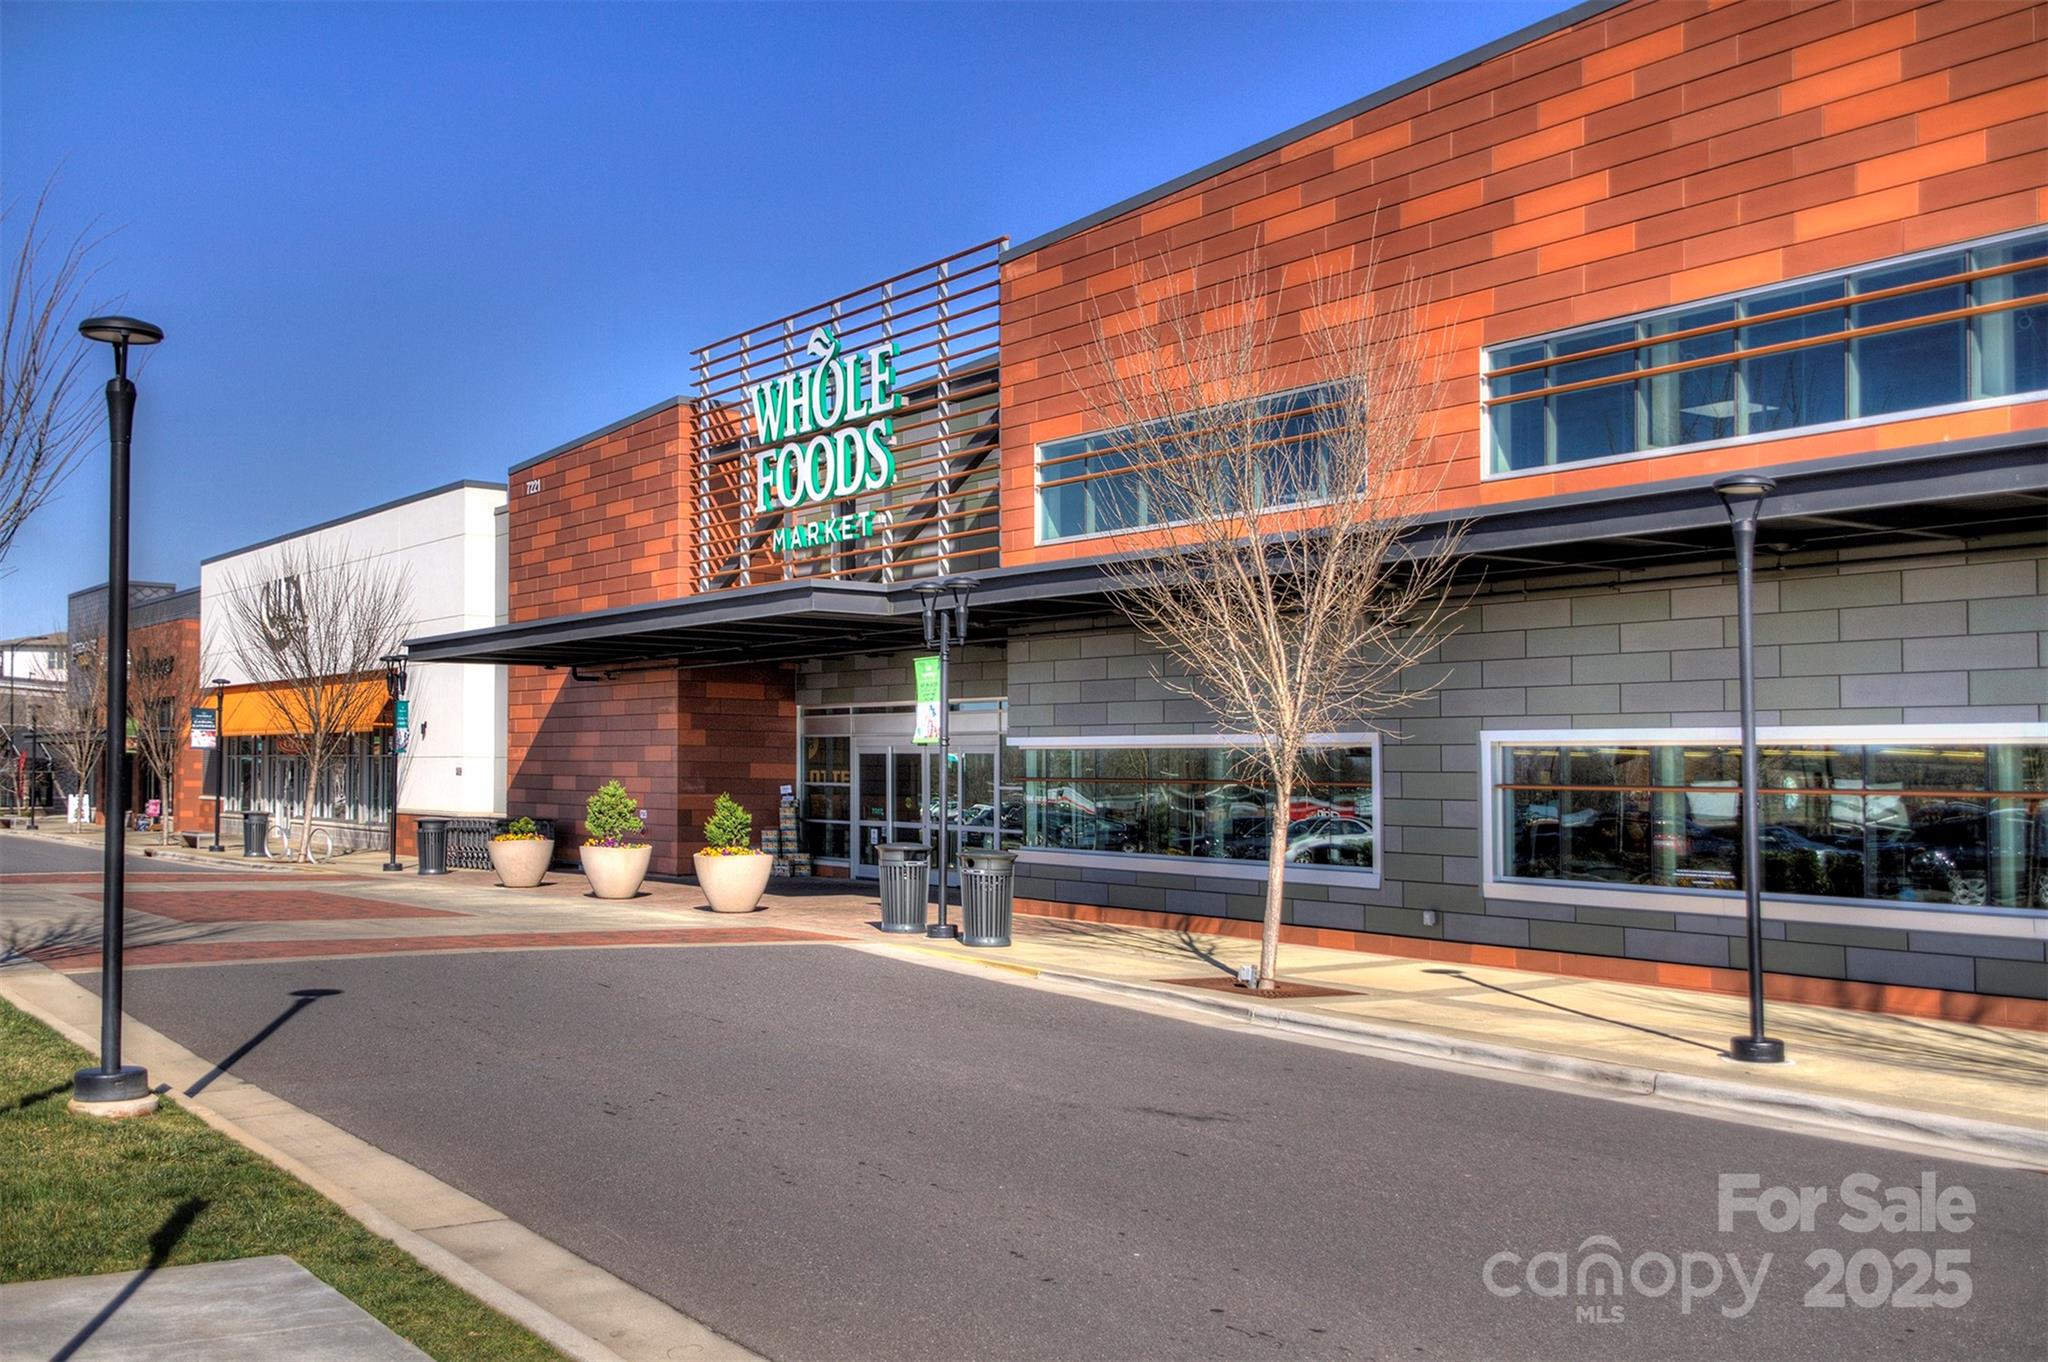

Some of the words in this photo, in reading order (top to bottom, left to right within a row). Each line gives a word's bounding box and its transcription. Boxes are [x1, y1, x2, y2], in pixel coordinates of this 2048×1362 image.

[752, 327, 903, 445] WHOLE
[754, 417, 895, 513] FOODS
[773, 510, 876, 553] MARKET
